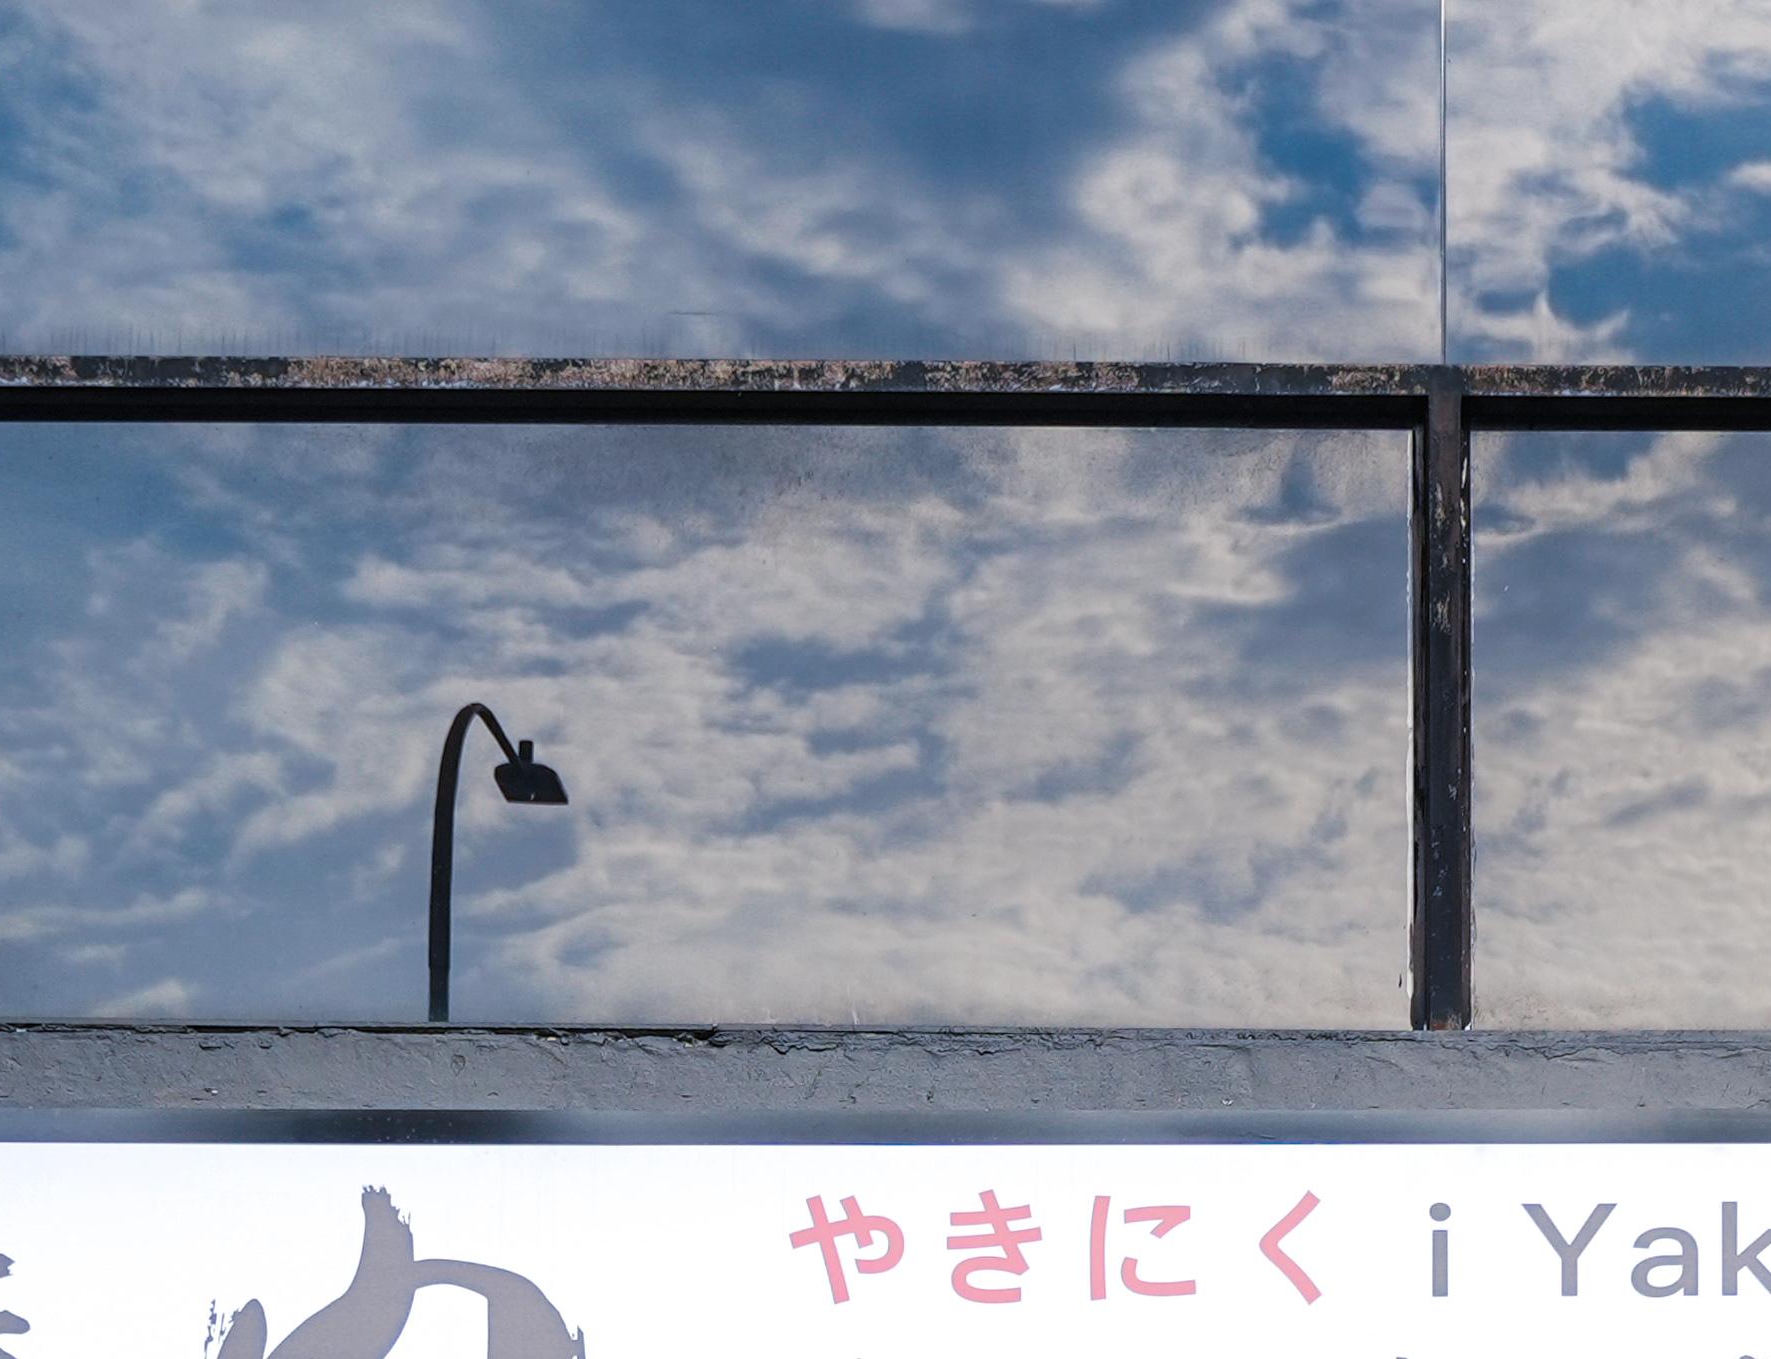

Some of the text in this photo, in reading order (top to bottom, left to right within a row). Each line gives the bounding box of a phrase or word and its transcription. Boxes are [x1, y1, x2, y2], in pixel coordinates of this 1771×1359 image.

[789, 1190, 1322, 1305] やきにく
[1429, 1203, 1451, 1297] i
